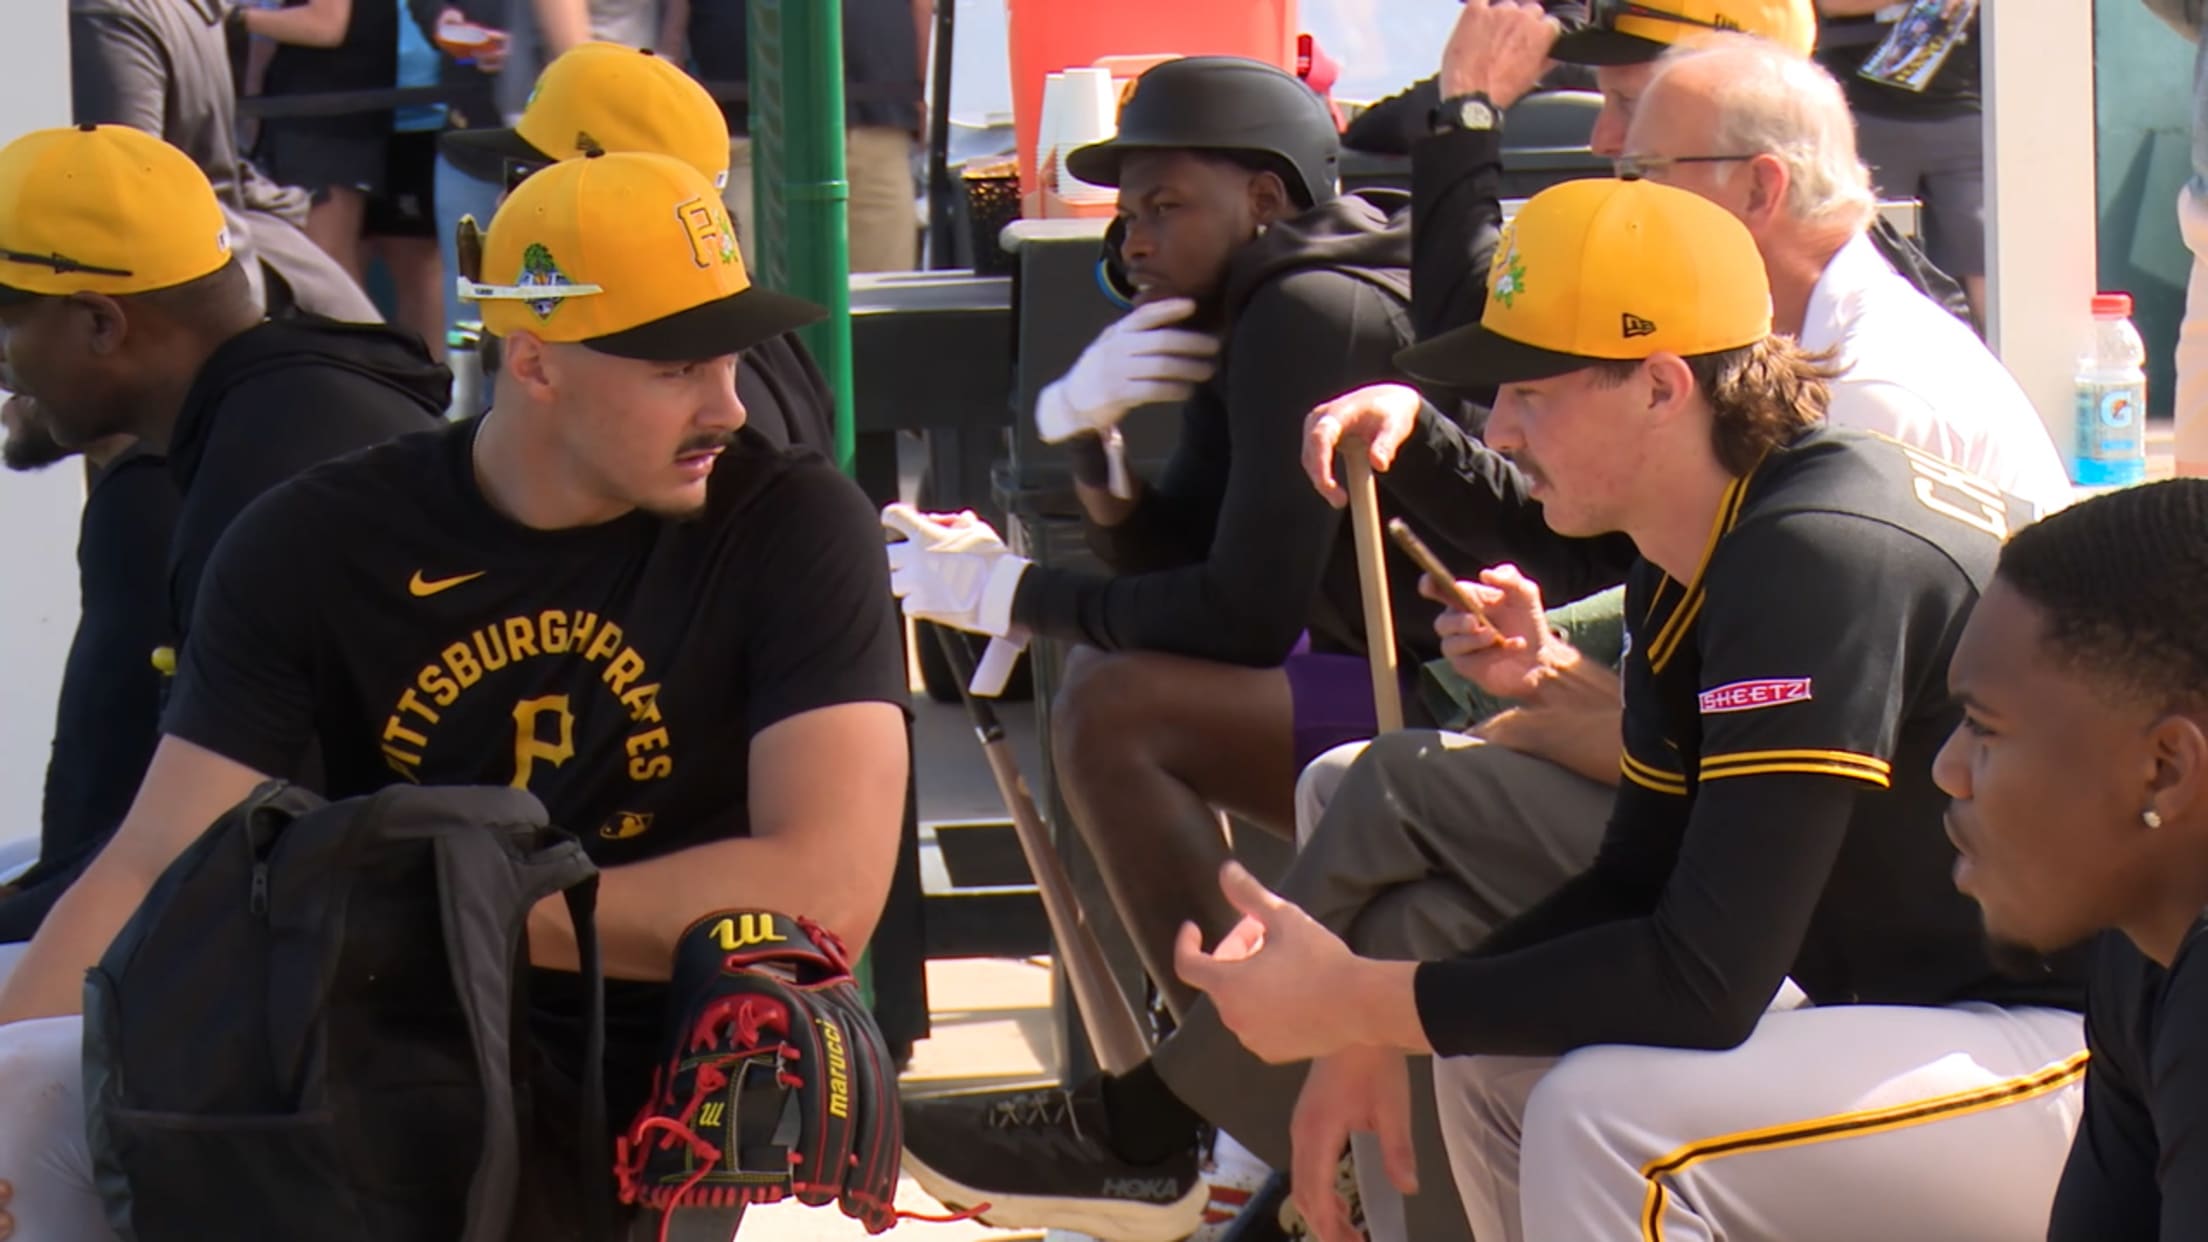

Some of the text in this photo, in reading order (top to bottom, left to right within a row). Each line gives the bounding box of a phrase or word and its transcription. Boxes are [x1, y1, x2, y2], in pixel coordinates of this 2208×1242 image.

[676, 197, 718, 269] P
[2101, 391, 2133, 428] G
[1703, 683, 1803, 710] SHEETZ
[510, 694, 575, 790] P
[815, 1018, 848, 1119] marucci
[1102, 1178, 1178, 1198] HOKA
